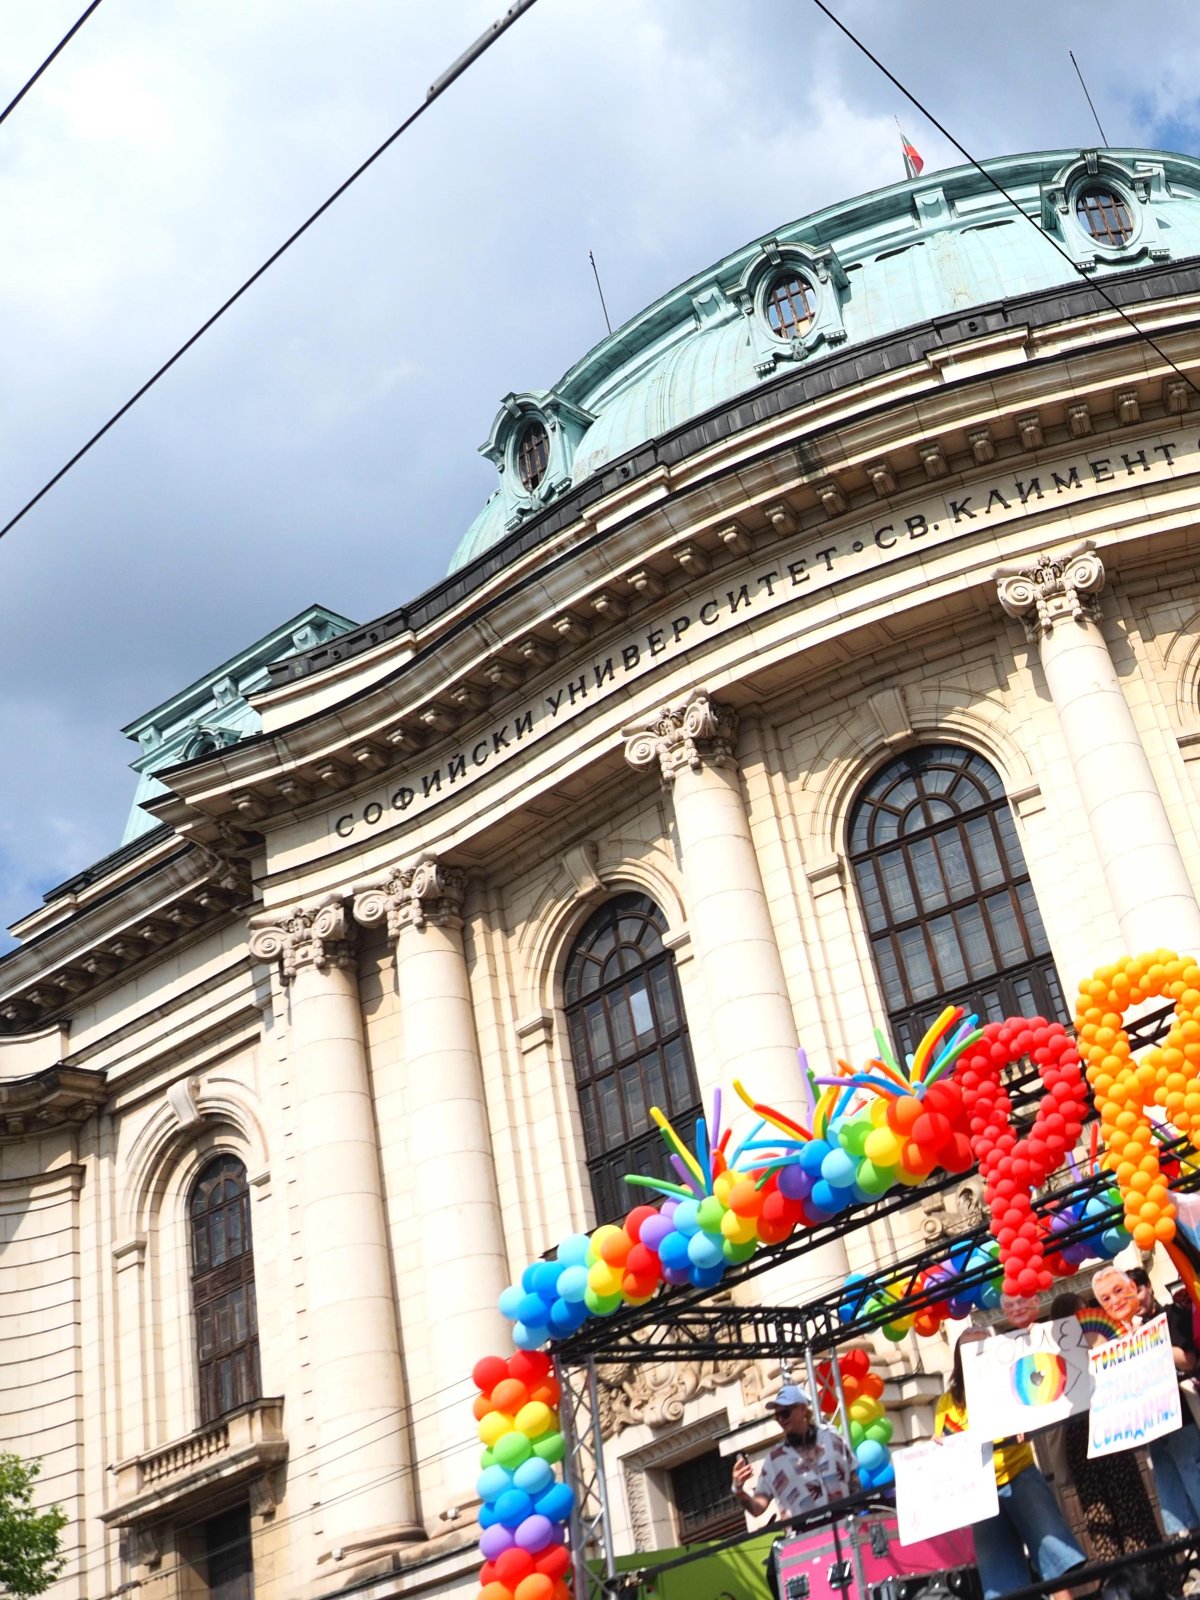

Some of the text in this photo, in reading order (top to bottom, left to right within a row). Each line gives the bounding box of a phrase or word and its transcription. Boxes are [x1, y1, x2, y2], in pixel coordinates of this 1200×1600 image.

[335, 711, 534, 838] СОФИЙСКИ
[546, 547, 838, 717] УНИВЕРСИТЕТ
[875, 514, 939, 549] СВ.
[950, 442, 1176, 523] КЛИМЕНТ
